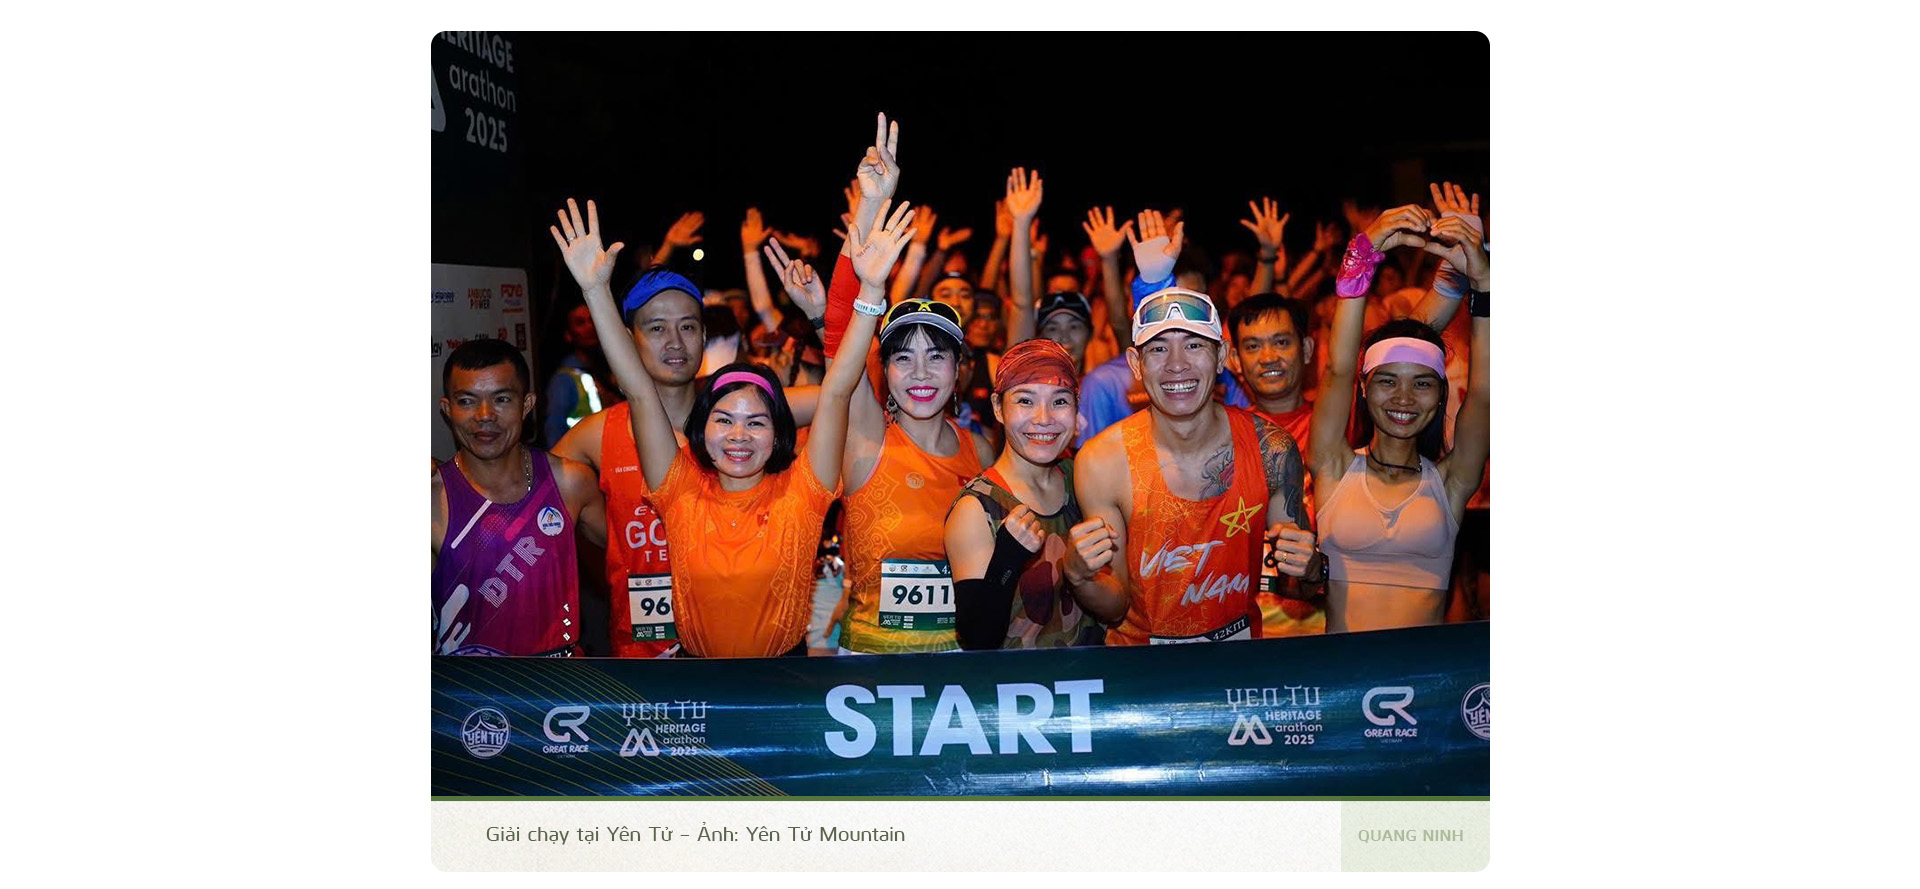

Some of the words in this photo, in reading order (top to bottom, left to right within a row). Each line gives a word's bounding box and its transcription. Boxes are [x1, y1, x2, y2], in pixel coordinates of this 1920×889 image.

[449, 64, 516, 112] arathon
[465, 107, 508, 152] 2025
[1139, 537, 1226, 580] VIET
[477, 535, 546, 608] DTR
[892, 585, 949, 605] 9611
[824, 679, 1104, 758] START
[1265, 710, 1322, 721] HERITAGE
[655, 723, 706, 734] HERITAGE
[1275, 722, 1323, 732] arathon
[1364, 729, 1393, 738] GREAT
[1395, 728, 1418, 737] RACE
[663, 736, 706, 745] arathon
[1284, 734, 1315, 745] 2025
[542, 745, 568, 754] GREAT
[569, 744, 589, 753] RACE
[671, 747, 697, 756] 2025
